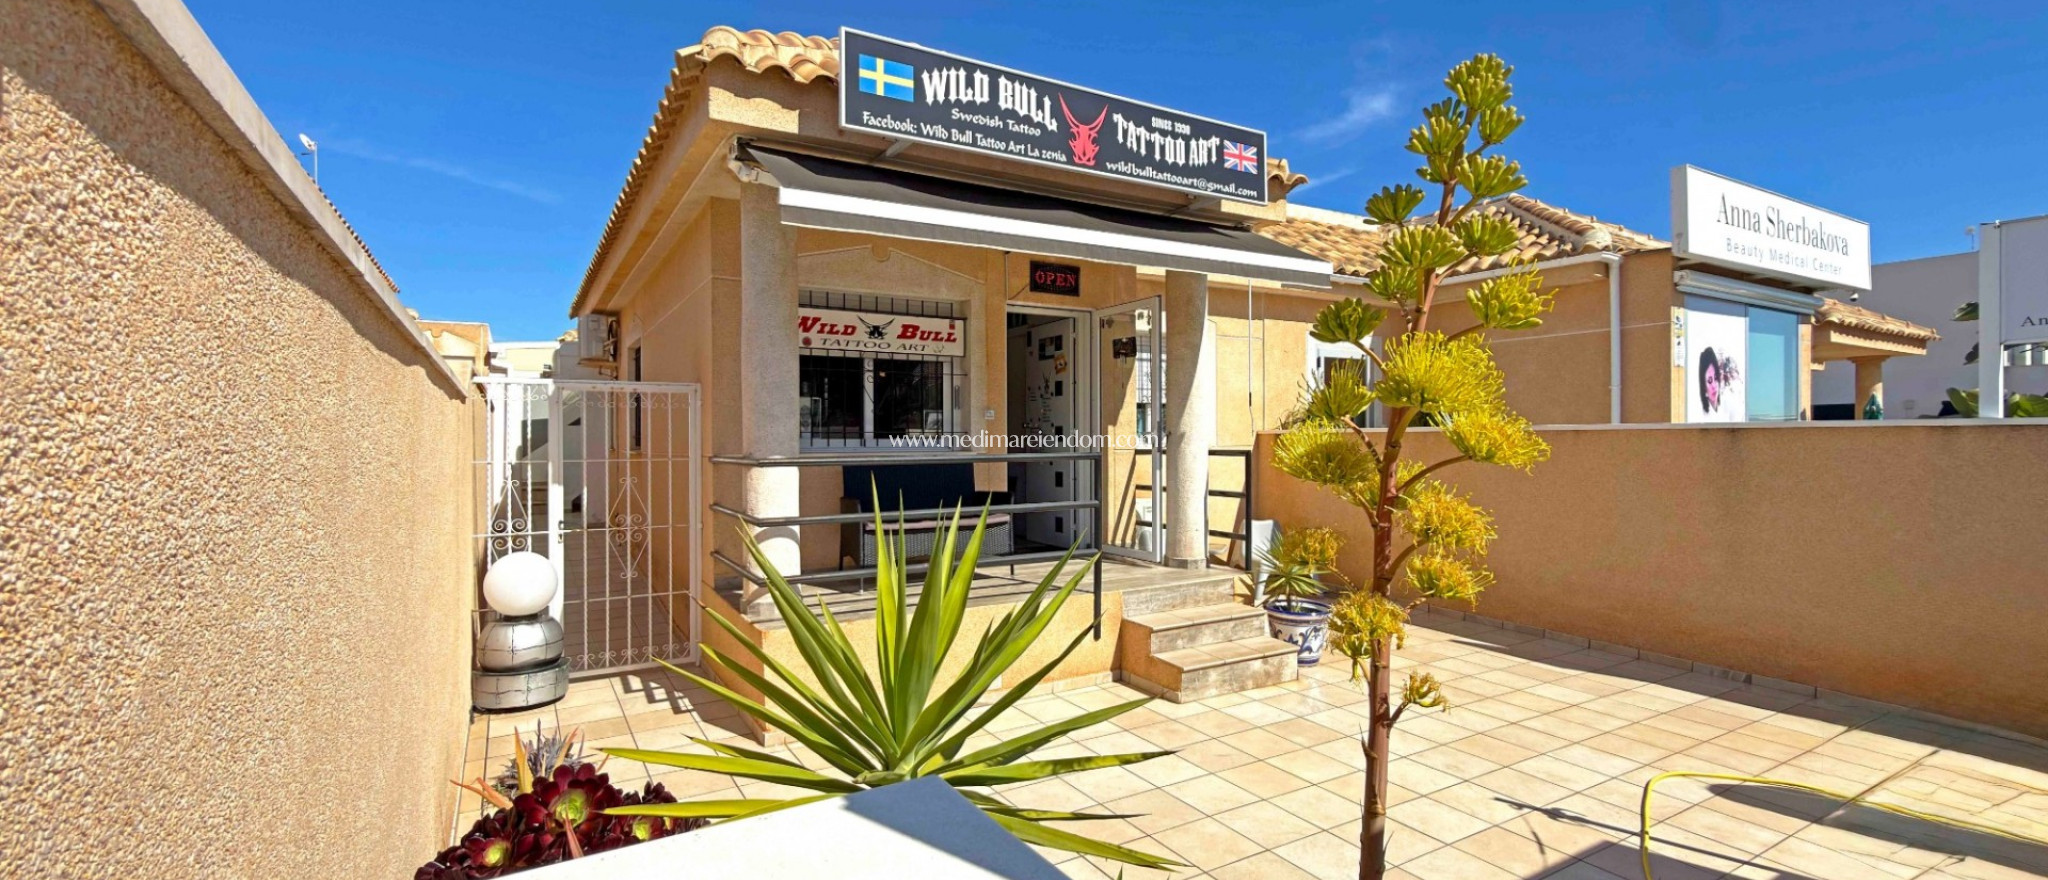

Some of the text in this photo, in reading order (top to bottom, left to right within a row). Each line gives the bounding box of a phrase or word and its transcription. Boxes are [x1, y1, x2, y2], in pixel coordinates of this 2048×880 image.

[921, 66, 1058, 133] WILD BULL
[862, 111, 1067, 162] Facebook: Wild Bull Tattoo Art La zenia
[951, 108, 1041, 137] Swedish Tattoo
[1112, 113, 1220, 167] TATTOO ART
[1151, 116, 1172, 131] SINCE
[1105, 161, 1258, 198] wildbulltattooart@gmail.com
[1716, 192, 1849, 256] Anna Sherbakova
[1726, 237, 1842, 275] Beauty Medical Center
[1035, 270, 1077, 287] OPEN
[799, 315, 957, 343] WILD BULL
[819, 337, 929, 352] TATTOO ART
